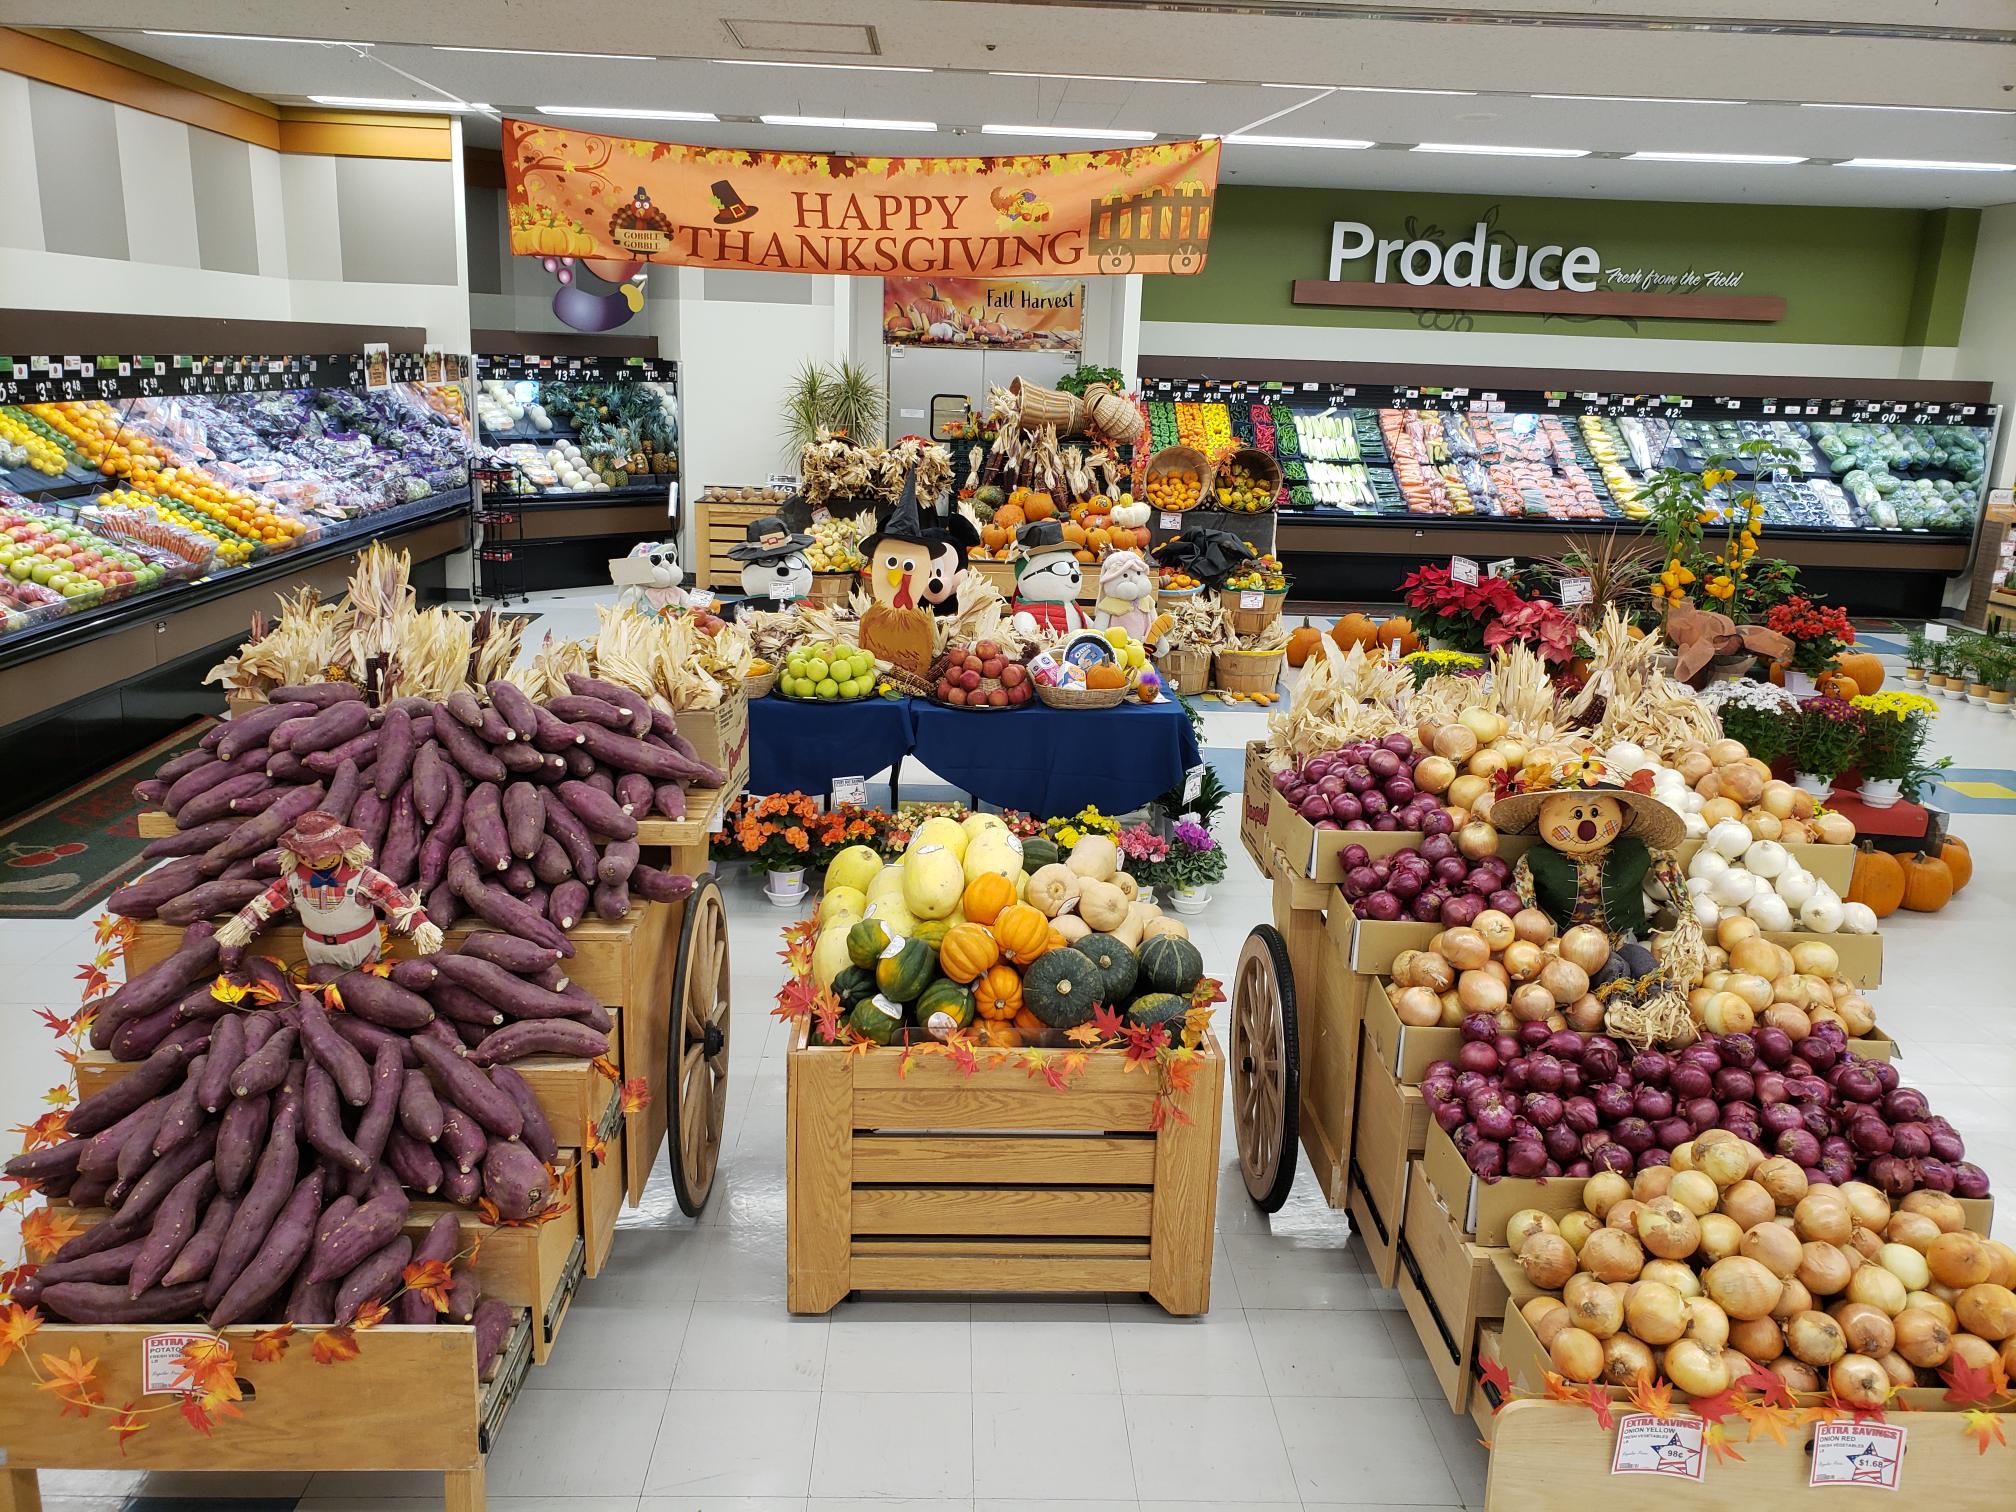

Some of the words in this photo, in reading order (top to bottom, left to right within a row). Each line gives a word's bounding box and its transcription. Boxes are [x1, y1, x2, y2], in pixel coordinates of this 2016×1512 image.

[792, 191, 967, 230] HAPPY
[623, 231, 660, 241] GOBBLE
[623, 240, 660, 250] GOBBLE
[678, 225, 1085, 274] THANKSGIVING
[1328, 221, 1600, 292] Produce
[1605, 267, 1642, 284] Fresh
[1641, 269, 1678, 290] from
[1680, 270, 1701, 286] the
[1704, 271, 1744, 287] Field
[986, 289, 1015, 308] Fall
[1021, 290, 1075, 309] Harvest
[1626, 1419, 1654, 1428] EXTRA
[1657, 1419, 1700, 1430] SAVINGS
[1821, 1427, 1849, 1435] EXTRA
[1852, 1427, 1897, 1439] SAVINGS
[1859, 1459, 1884, 1468] $1.68
